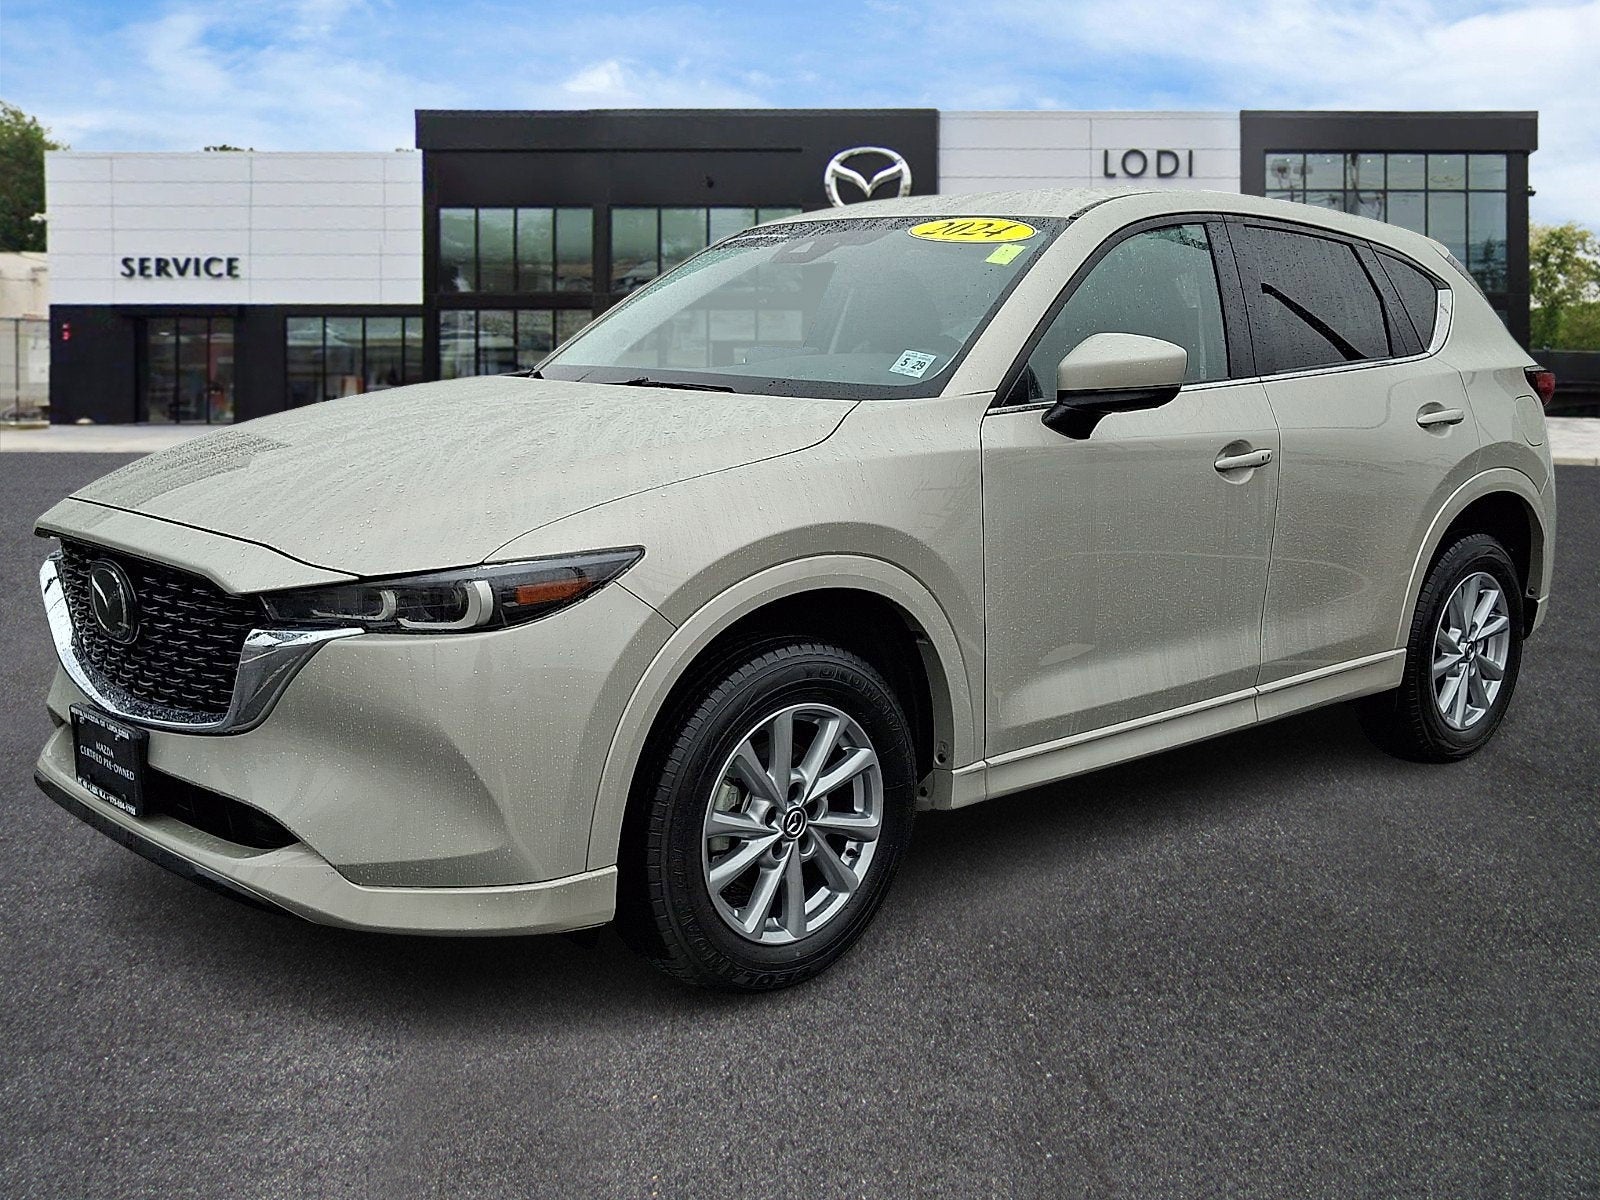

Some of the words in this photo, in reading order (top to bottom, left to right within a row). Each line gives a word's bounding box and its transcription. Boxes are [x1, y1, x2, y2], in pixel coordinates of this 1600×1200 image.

[1103, 149, 1193, 178] LODI
[921, 221, 1018, 238] 2024
[120, 257, 240, 278] SERVICE
[900, 357, 911, 367] 5
[910, 360, 926, 371] 29
[95, 741, 114, 759] MAZDA
[103, 757, 135, 781] PRE-OWNED
